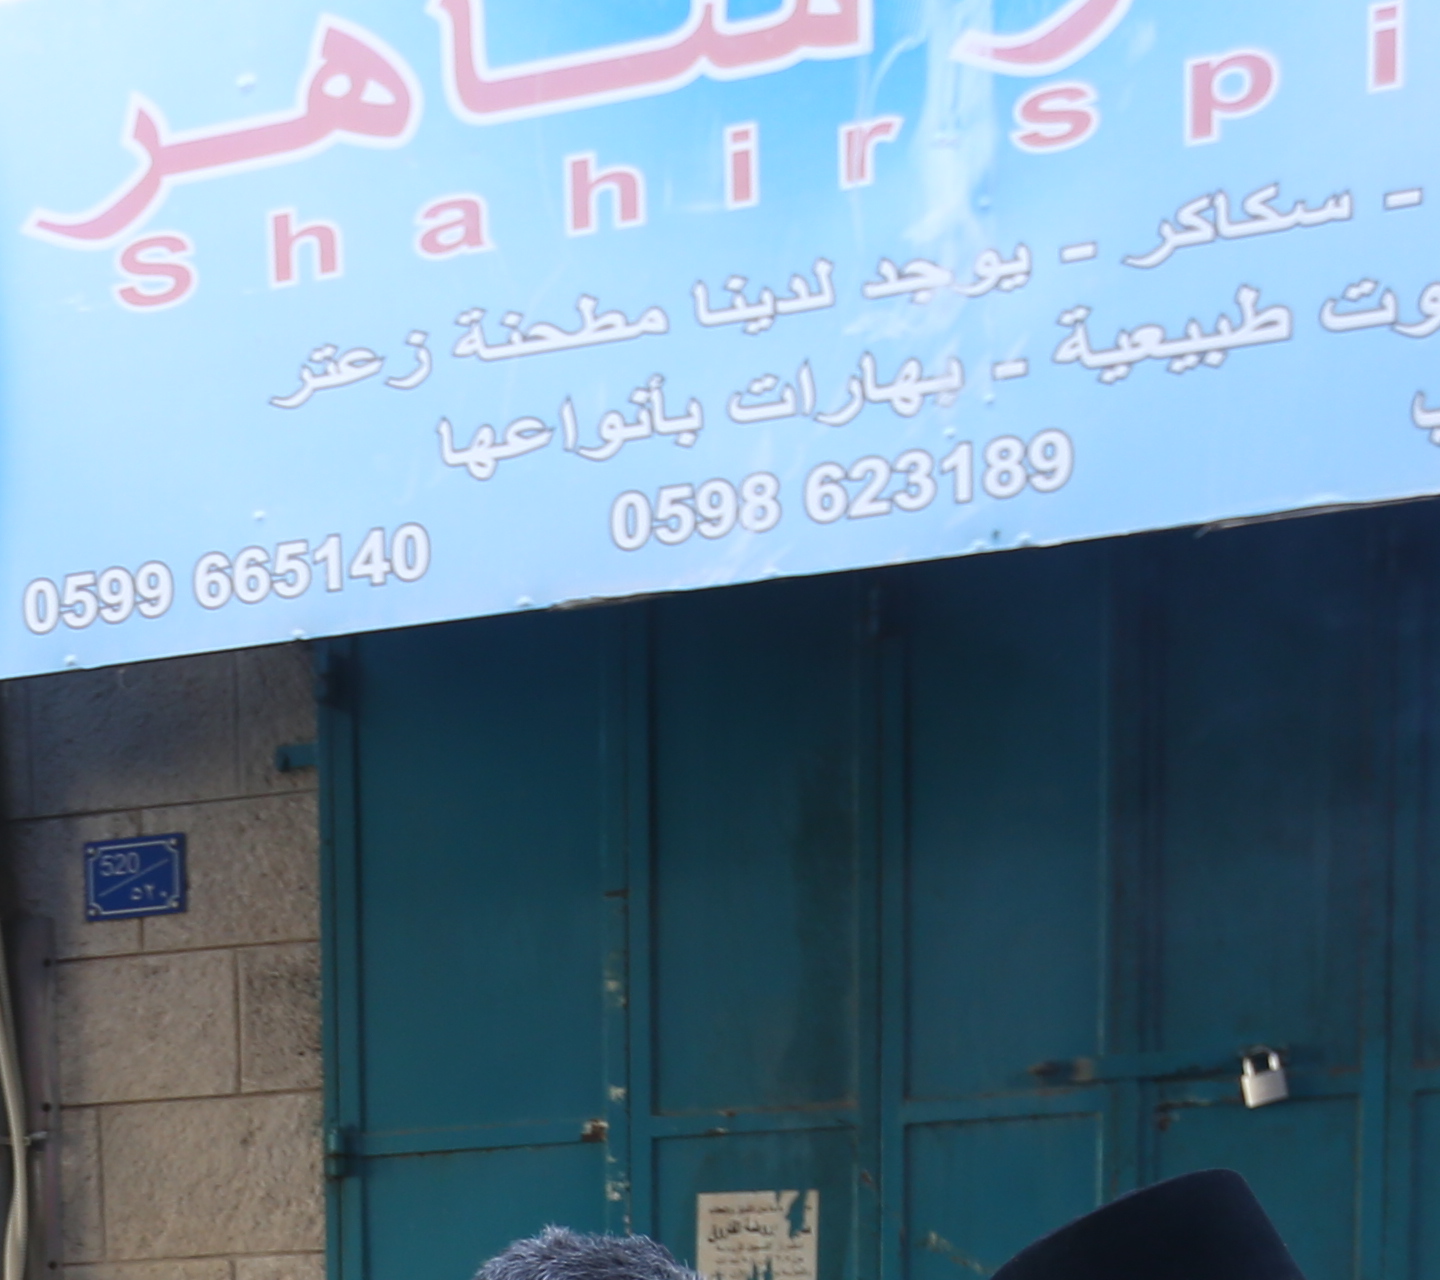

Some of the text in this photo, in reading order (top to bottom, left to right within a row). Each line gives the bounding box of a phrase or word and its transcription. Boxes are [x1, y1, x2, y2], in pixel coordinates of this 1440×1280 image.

[114, 112, 905, 310] Shahir
[1120, 183, 1353, 268] سكاكر
[692, 257, 837, 336] لدينا
[862, 241, 1032, 303] يوجد
[269, 330, 434, 410] زعتر
[451, 293, 671, 362] مطحنة
[1052, 283, 1294, 385] طبيعية
[436, 373, 705, 482] بأنواعها
[726, 350, 965, 428] بهارات
[609, 428, 1076, 552] 0598 623189
[22, 521, 431, 635] 0599 665140
